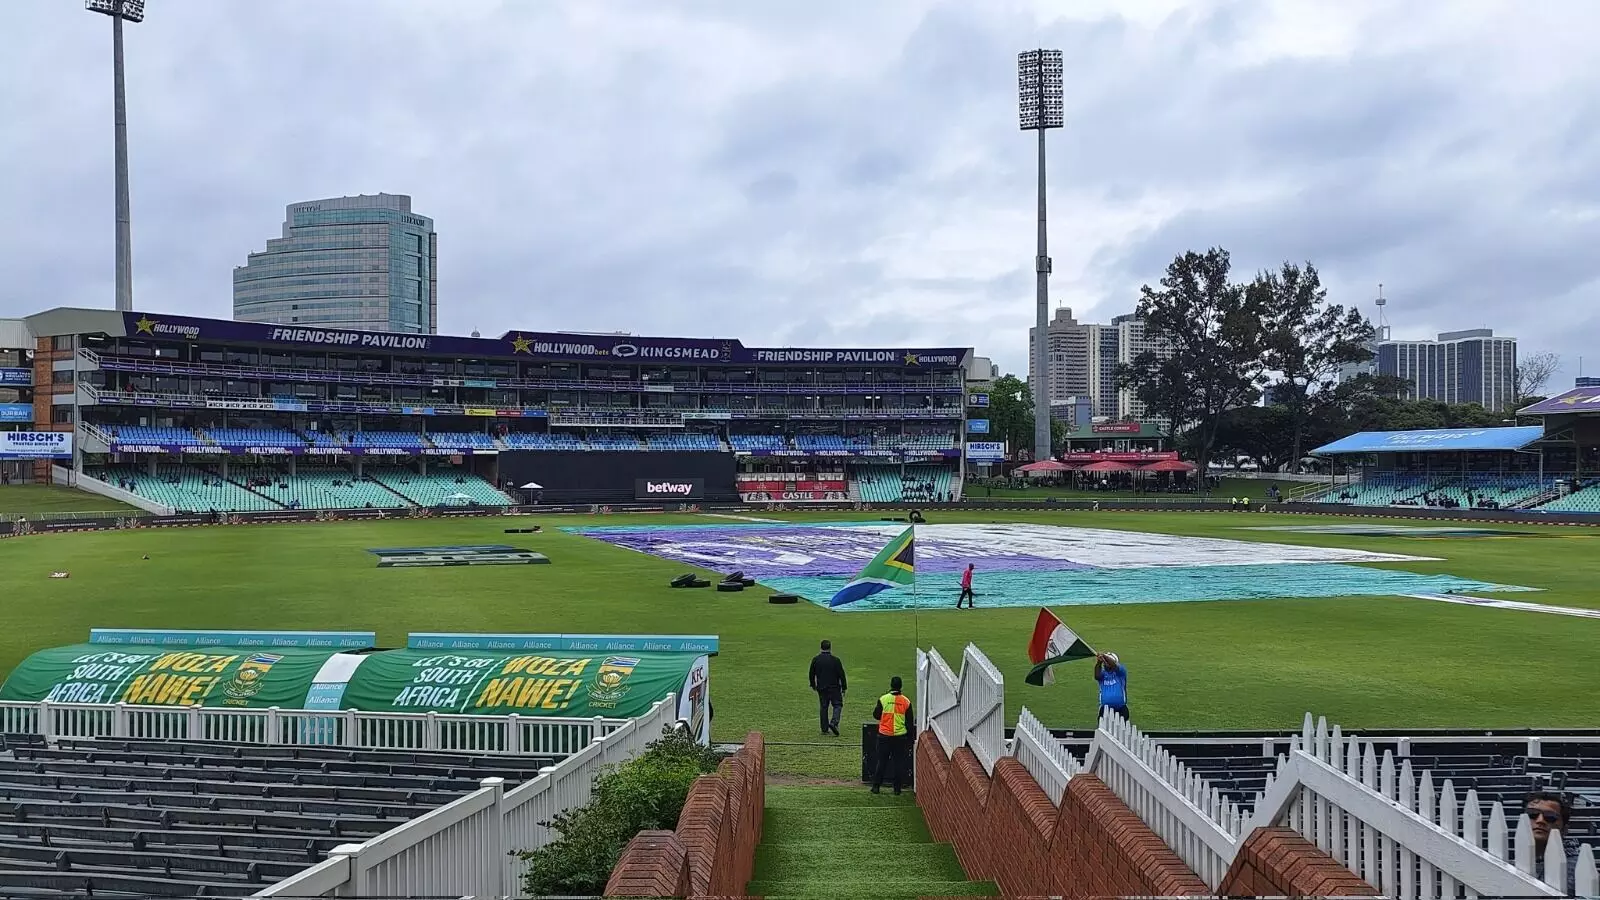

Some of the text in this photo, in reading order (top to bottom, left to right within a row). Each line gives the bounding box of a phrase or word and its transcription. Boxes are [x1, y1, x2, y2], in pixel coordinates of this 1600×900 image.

[153, 323, 200, 335] HOLLYWOOD
[272, 328, 426, 349] FRIENDSHIP PAVILION
[640, 347, 719, 358] KINGSMEAD
[757, 351, 895, 361] FRIENDSHIP PAVILION
[918, 355, 957, 363] HOLLYWOOD
[7, 432, 65, 442] HIRSCH'S
[647, 482, 692, 495] betway
[97, 635, 367, 648] Alliance Alliance Alliance Alliance Alliance Alliance Alliance Alliance
[416, 639, 709, 650] Alliance Alliance Alliance Alliance Alliance Alliance Alliance Alliance
[149, 652, 239, 672] WOZA
[412, 655, 468, 667] LET'S
[500, 656, 590, 676] WOZA
[66, 663, 130, 680] SOUTH
[413, 667, 480, 684] SOUTH
[691, 664, 704, 685] KFC
[46, 682, 108, 702] AFRICA
[122, 673, 221, 705] NAWE!
[391, 686, 461, 707] AFRICA
[475, 677, 584, 709] NAWE!
[588, 701, 617, 709] CRICKET
